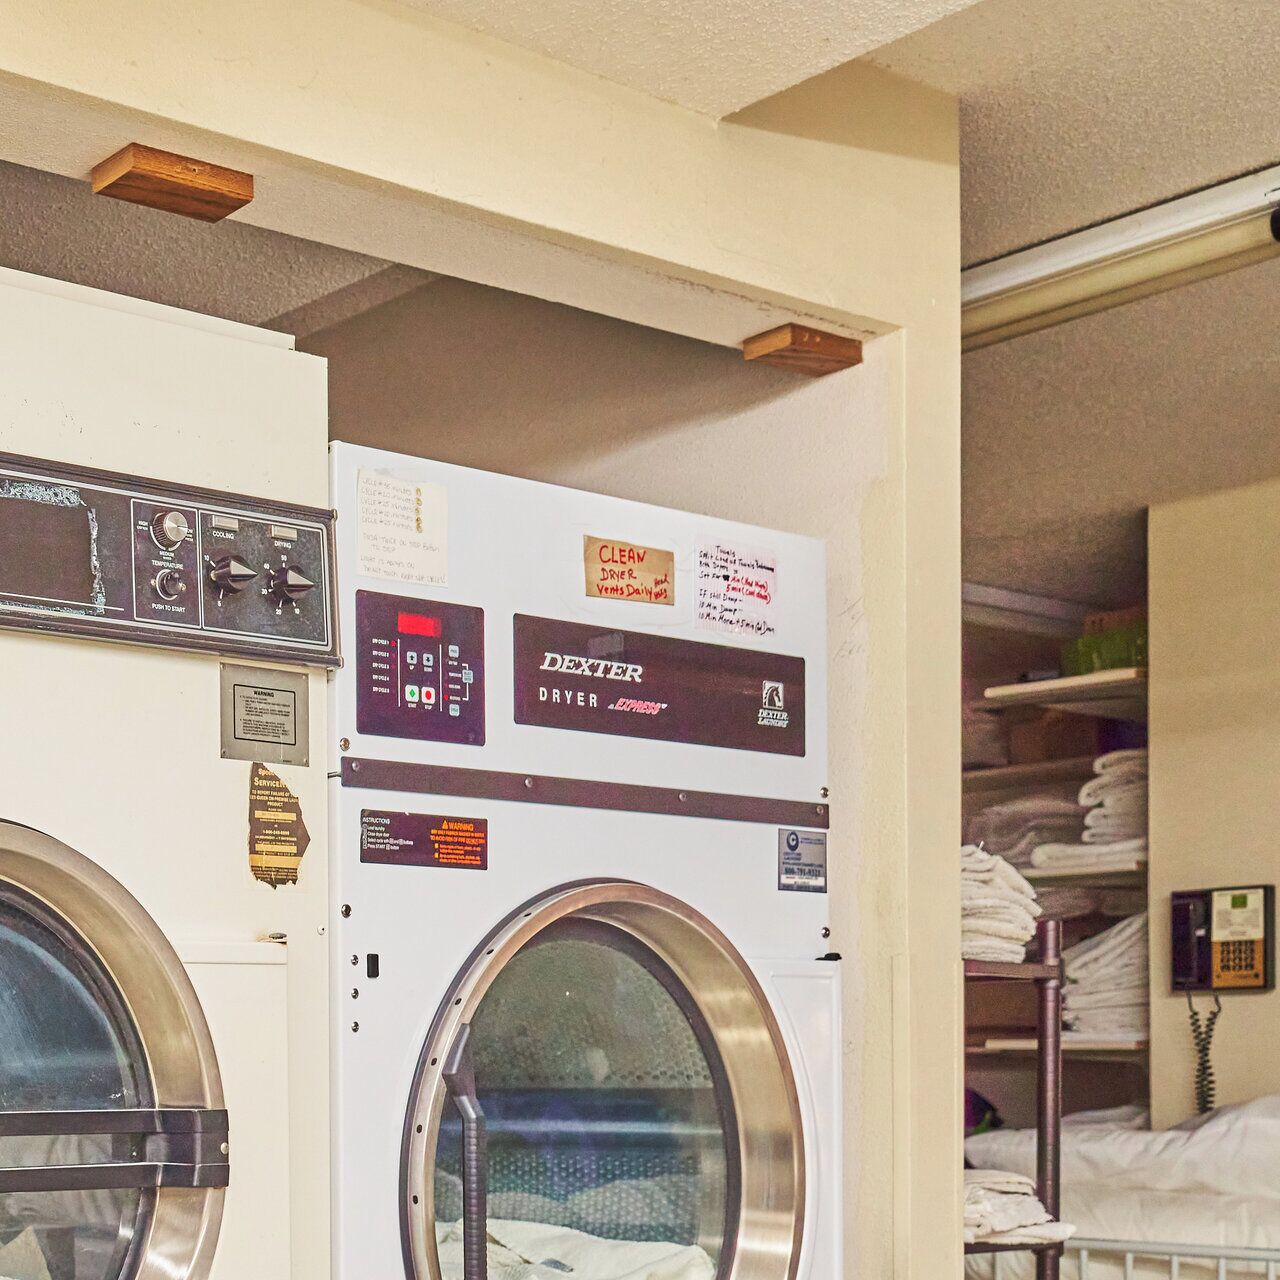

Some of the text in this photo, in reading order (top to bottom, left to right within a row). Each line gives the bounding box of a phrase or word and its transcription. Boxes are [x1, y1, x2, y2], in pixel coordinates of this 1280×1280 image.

[212, 531, 234, 539] COOLING
[599, 544, 646, 564] CLEAN
[152, 560, 184, 570] TEMPERATURE
[600, 567, 637, 582] DRYER
[626, 583, 652, 600] Daily
[540, 652, 643, 683] DEXTER
[539, 687, 661, 715] DRYER EXPRESS
[449, 822, 474, 831] WARNING
